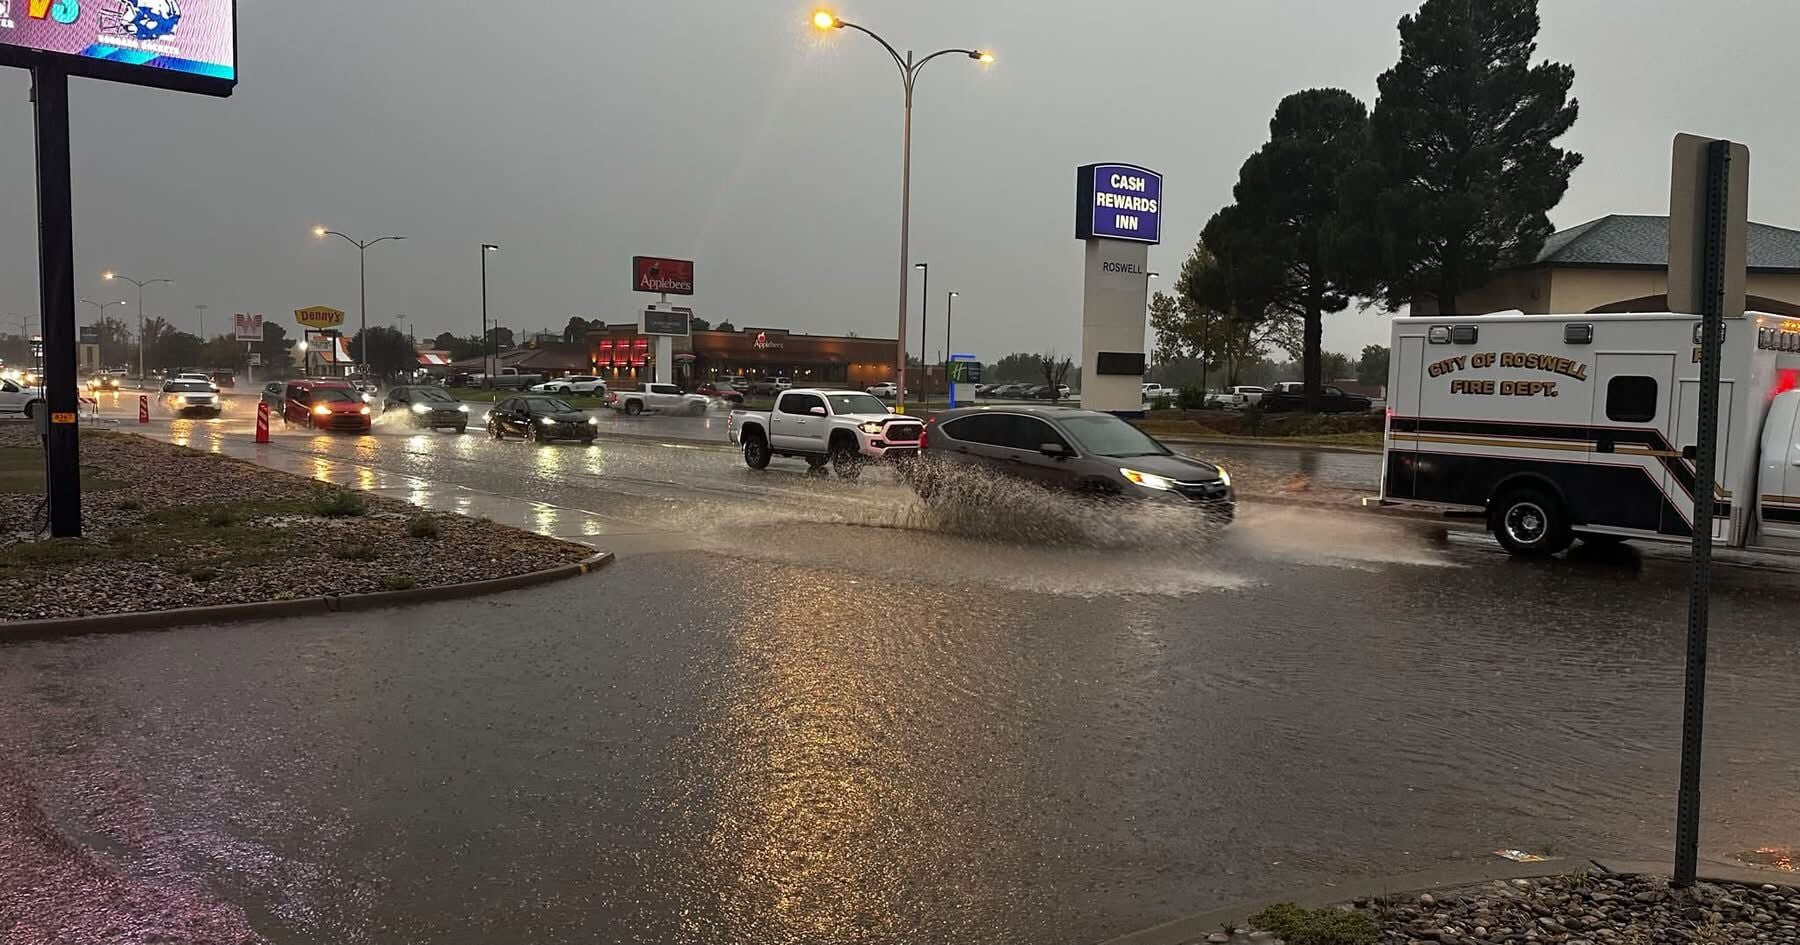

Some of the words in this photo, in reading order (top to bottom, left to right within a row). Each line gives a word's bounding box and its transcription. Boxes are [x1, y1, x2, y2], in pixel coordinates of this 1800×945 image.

[1110, 173, 1145, 192] CASH
[1096, 192, 1157, 213] REWARDS
[1115, 214, 1139, 230] INN
[1103, 261, 1142, 274] ROSWELL
[640, 273, 691, 290] Applebee's
[301, 310, 341, 322] Denny's
[1428, 354, 1467, 378] CITY
[1471, 352, 1497, 368] OF
[1500, 352, 1588, 382] ROSWELL
[1450, 380, 1495, 395] FIRE
[1500, 380, 1559, 397] DEPT.
